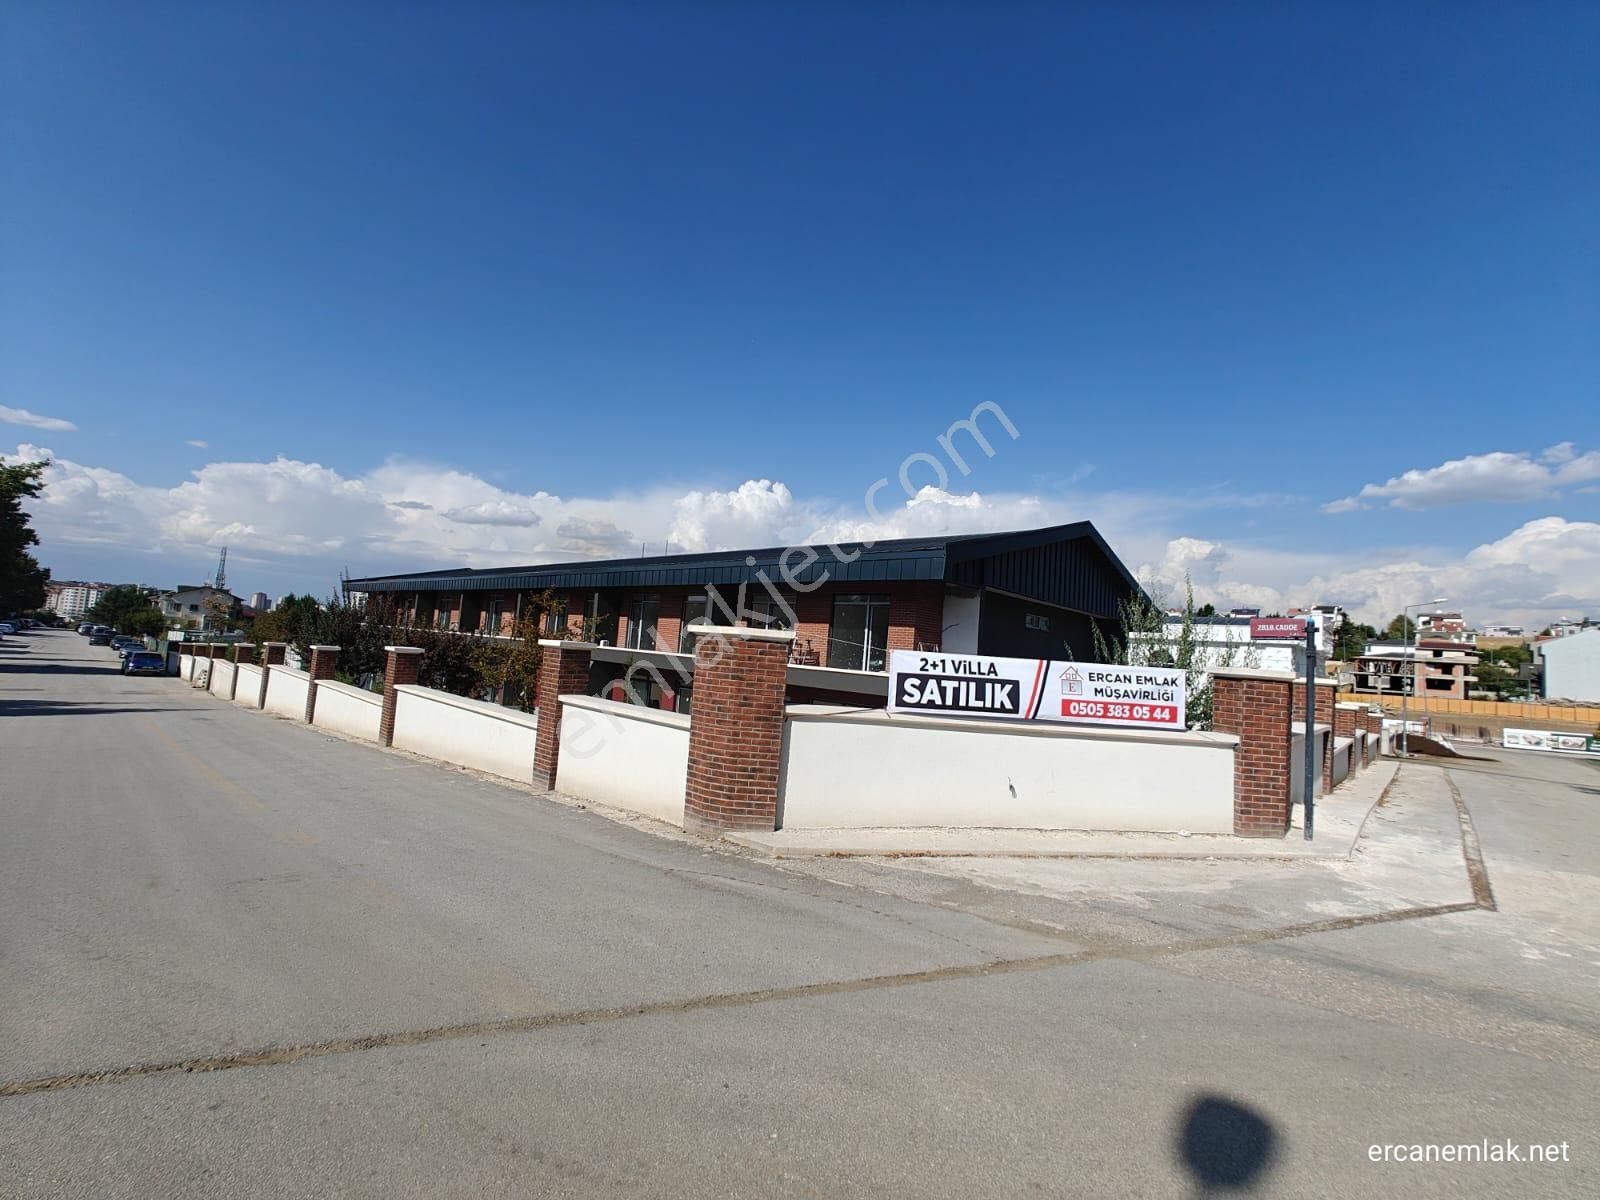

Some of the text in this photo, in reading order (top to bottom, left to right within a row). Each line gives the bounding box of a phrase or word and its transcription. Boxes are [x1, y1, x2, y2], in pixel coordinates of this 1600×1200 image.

[919, 657, 947, 673] 2+1
[1088, 672, 1179, 687] ERCAN EMLAK
[902, 677, 1014, 710] SATILIK
[1094, 686, 1175, 702] MÜŞAVİRLİĞİ
[1069, 702, 1171, 721] 0505 383 05 44
